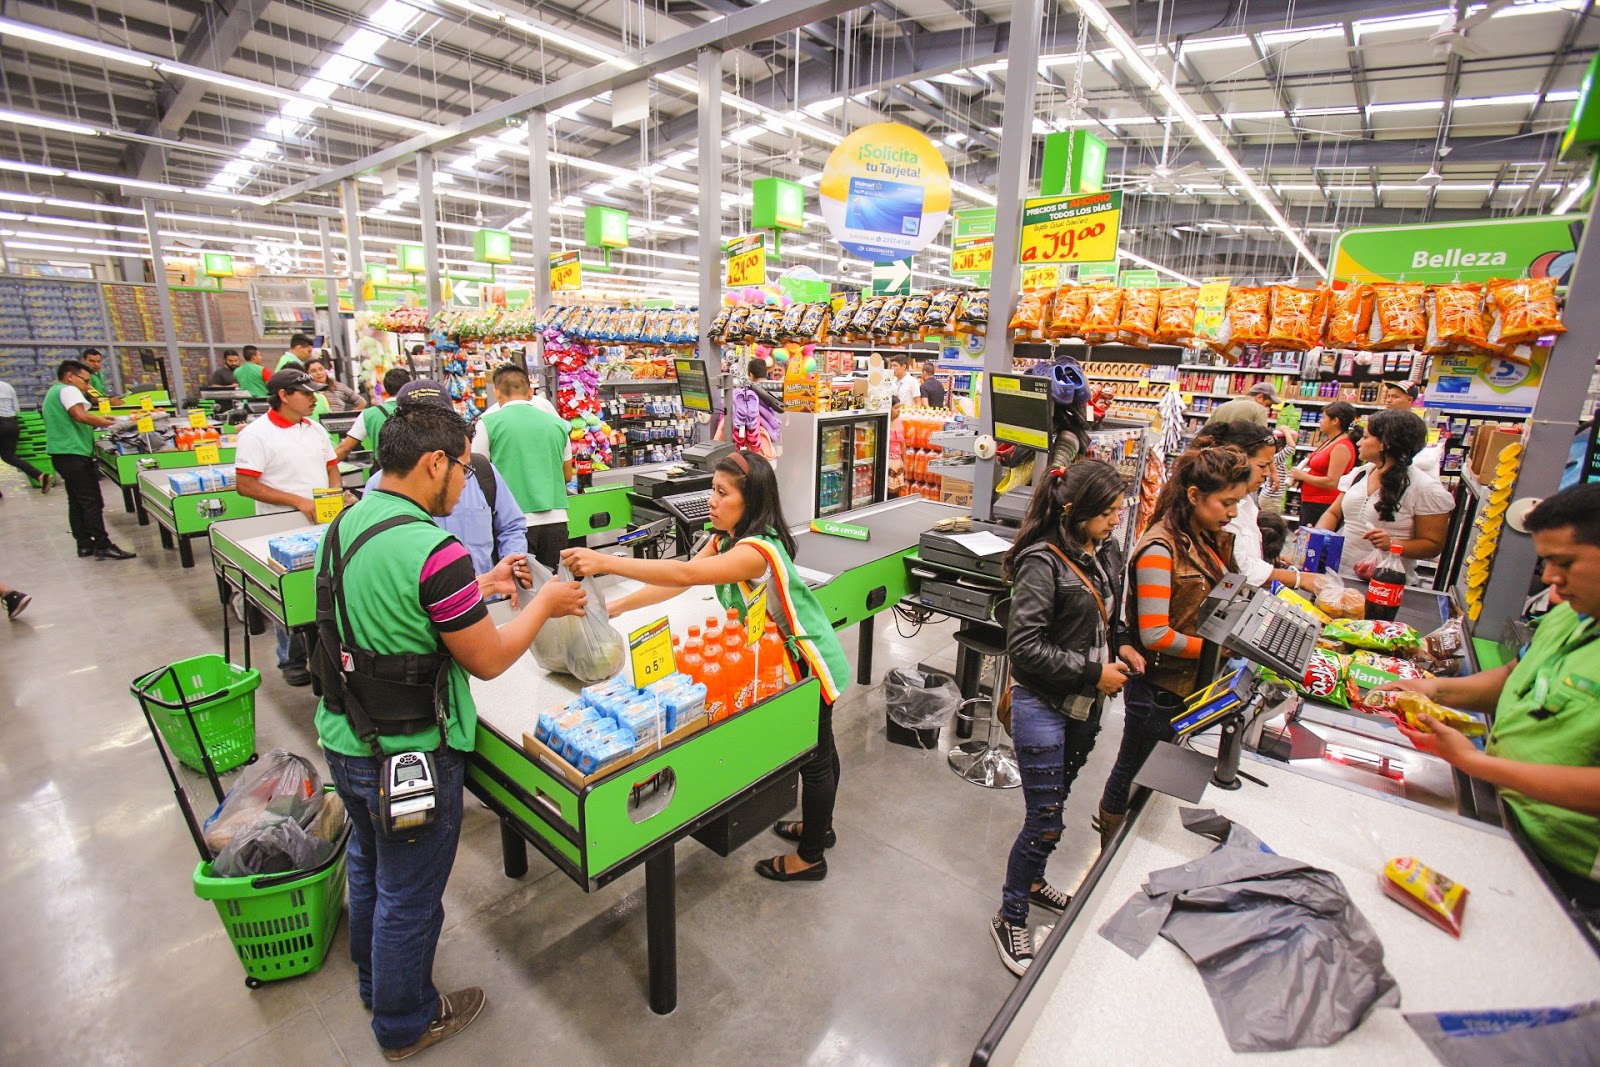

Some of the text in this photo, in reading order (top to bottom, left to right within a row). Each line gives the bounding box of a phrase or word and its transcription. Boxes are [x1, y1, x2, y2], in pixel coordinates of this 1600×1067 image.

[858, 144, 918, 164] ¡Solicita
[1088, 145, 1100, 179] 7
[866, 162, 920, 178] tu Tarjeta!
[1026, 193, 1111, 216] PRECIOS DE AHORRO
[1049, 202, 1112, 220] TODOS LOS DÍAS
[1022, 246, 1038, 262] a
[1412, 248, 1506, 268] Belleza
[1441, 358, 1468, 366] más!
[824, 524, 866, 536] Caja cerrada
